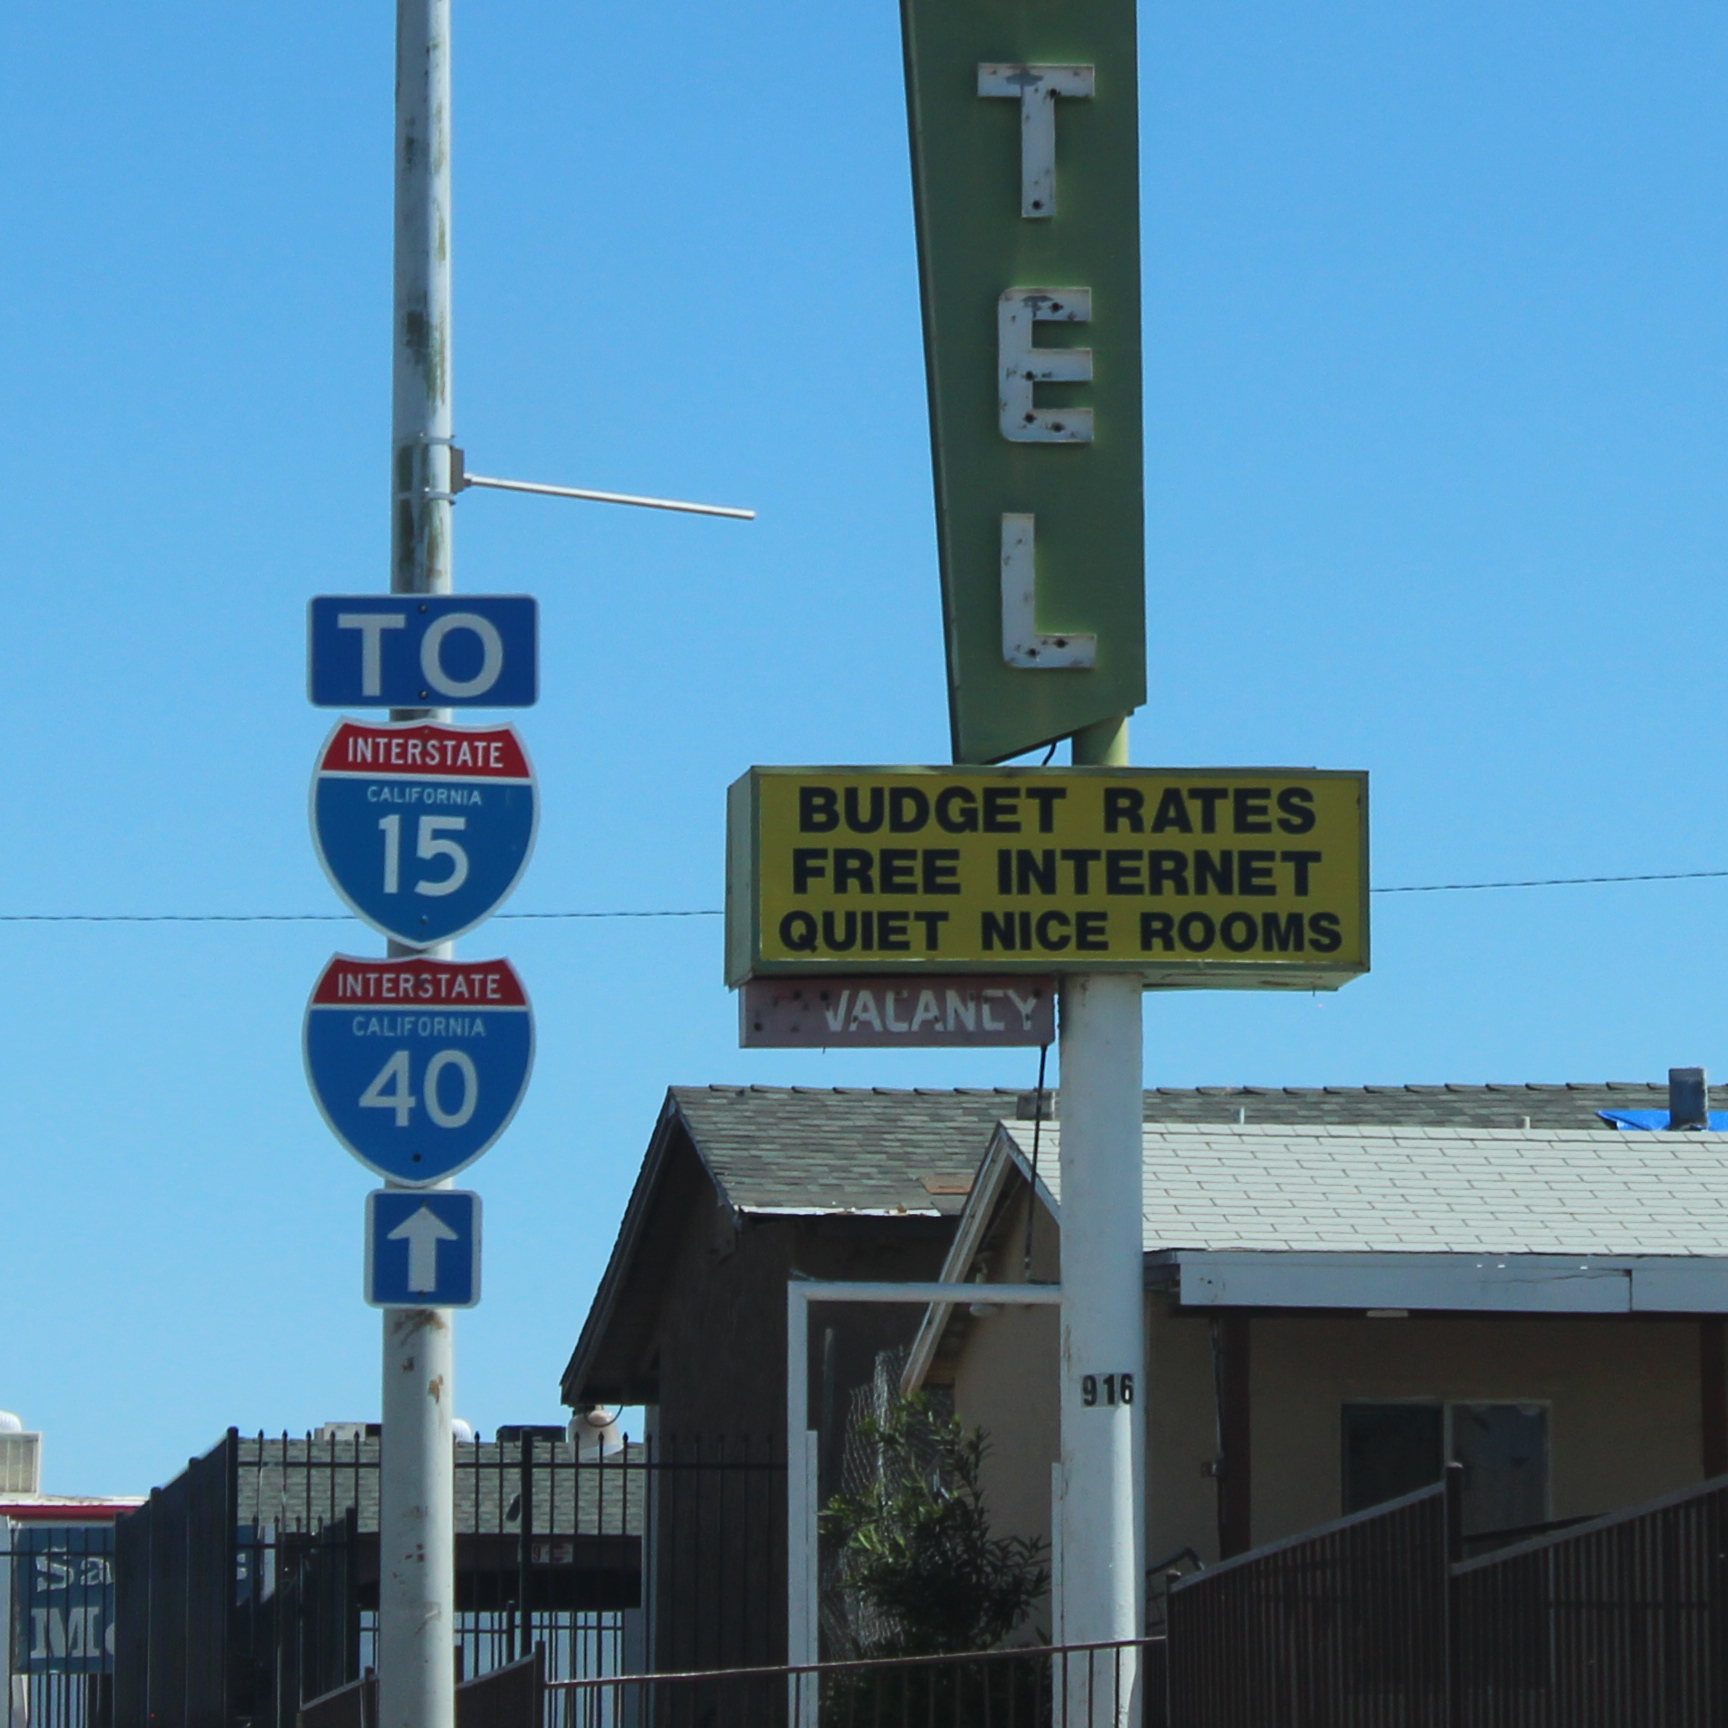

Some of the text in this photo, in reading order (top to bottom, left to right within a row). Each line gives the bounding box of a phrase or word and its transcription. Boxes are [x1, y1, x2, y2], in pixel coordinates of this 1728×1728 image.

[337, 612, 504, 698] TO
[347, 736, 504, 769] INTERSTATE
[366, 786, 482, 806] CALIFORNIA
[798, 786, 1317, 835] BUDGET RATES
[378, 813, 470, 898] 15
[792, 847, 1322, 898] FREE INTERNET
[778, 909, 1343, 953] QUIET NICE ROOMS
[337, 973, 503, 999] INTERSTATE
[351, 1015, 487, 1038] CALIFORNIA
[822, 988, 1041, 1033] VACANCY
[358, 1049, 479, 1129] 40
[1082, 1373, 1134, 1407] 916
